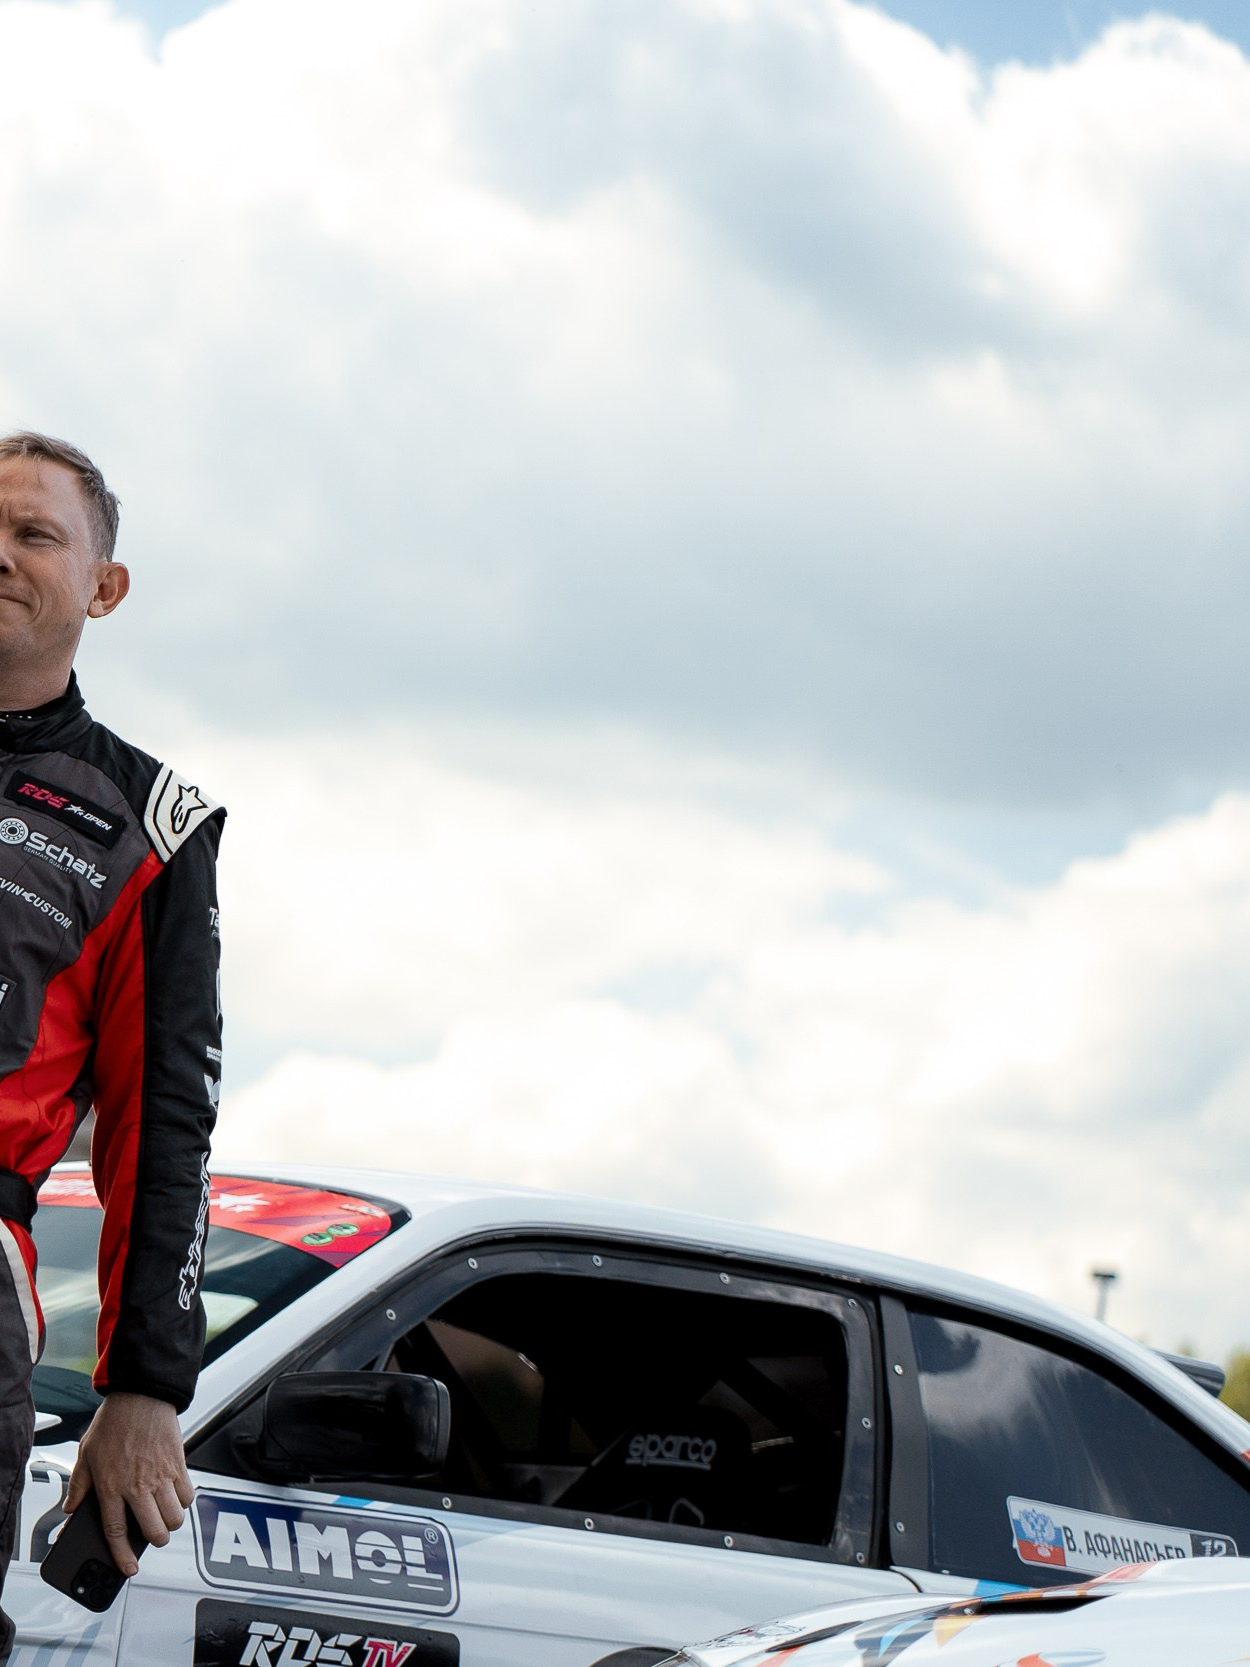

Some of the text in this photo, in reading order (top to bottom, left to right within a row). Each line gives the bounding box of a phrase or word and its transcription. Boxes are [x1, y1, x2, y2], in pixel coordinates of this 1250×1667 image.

[18, 783, 112, 831] RDS OPEN
[23, 846, 73, 874] GERMAN QUALITY
[25, 832, 107, 889] Schatz
[627, 1434, 717, 1468] sparco
[1063, 1526, 1083, 1554] В.
[1201, 1538, 1227, 1558] 12
[239, 1621, 417, 1667] RDS TV
